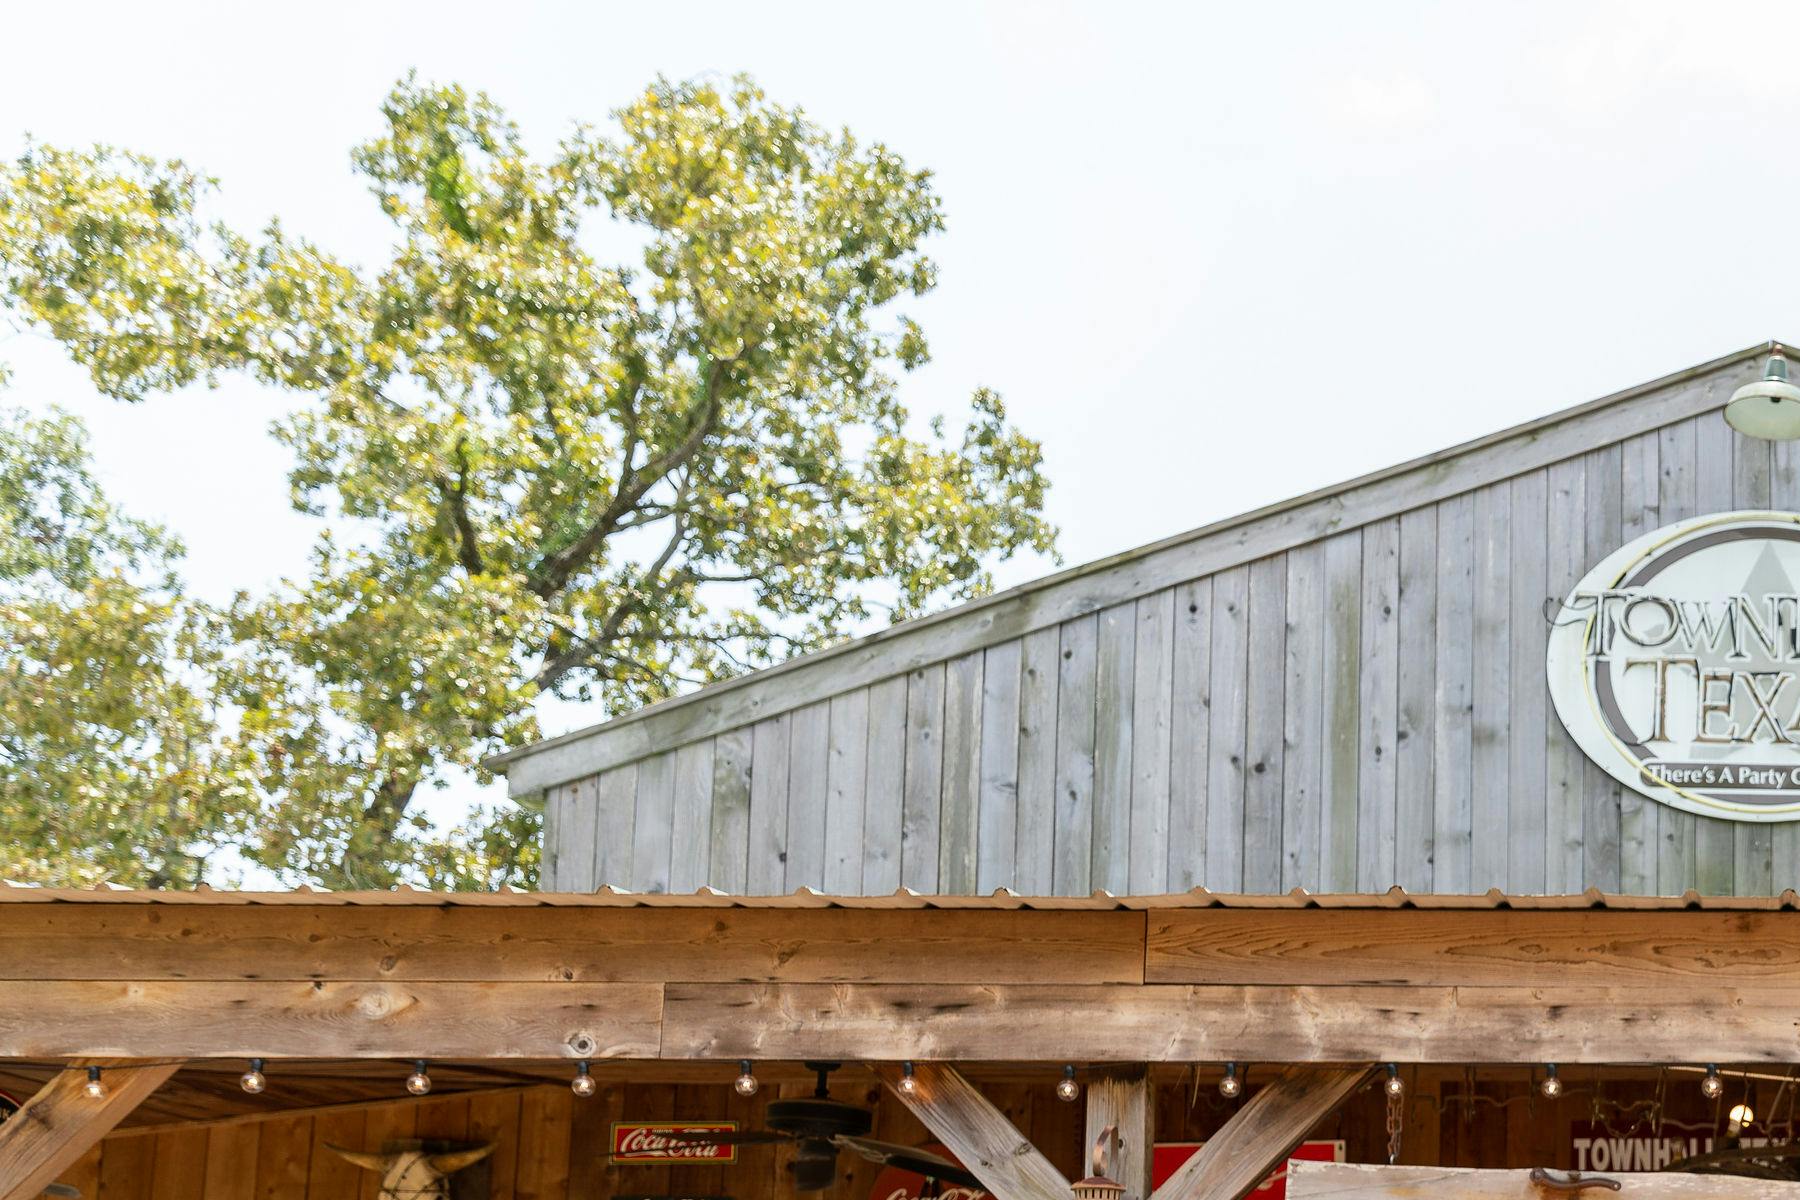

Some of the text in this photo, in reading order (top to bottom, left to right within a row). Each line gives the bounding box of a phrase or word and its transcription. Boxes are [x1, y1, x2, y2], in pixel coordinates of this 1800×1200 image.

[1649, 764, 1716, 786] There's
[1719, 766, 1735, 785] A
[1738, 767, 1787, 789] Party
